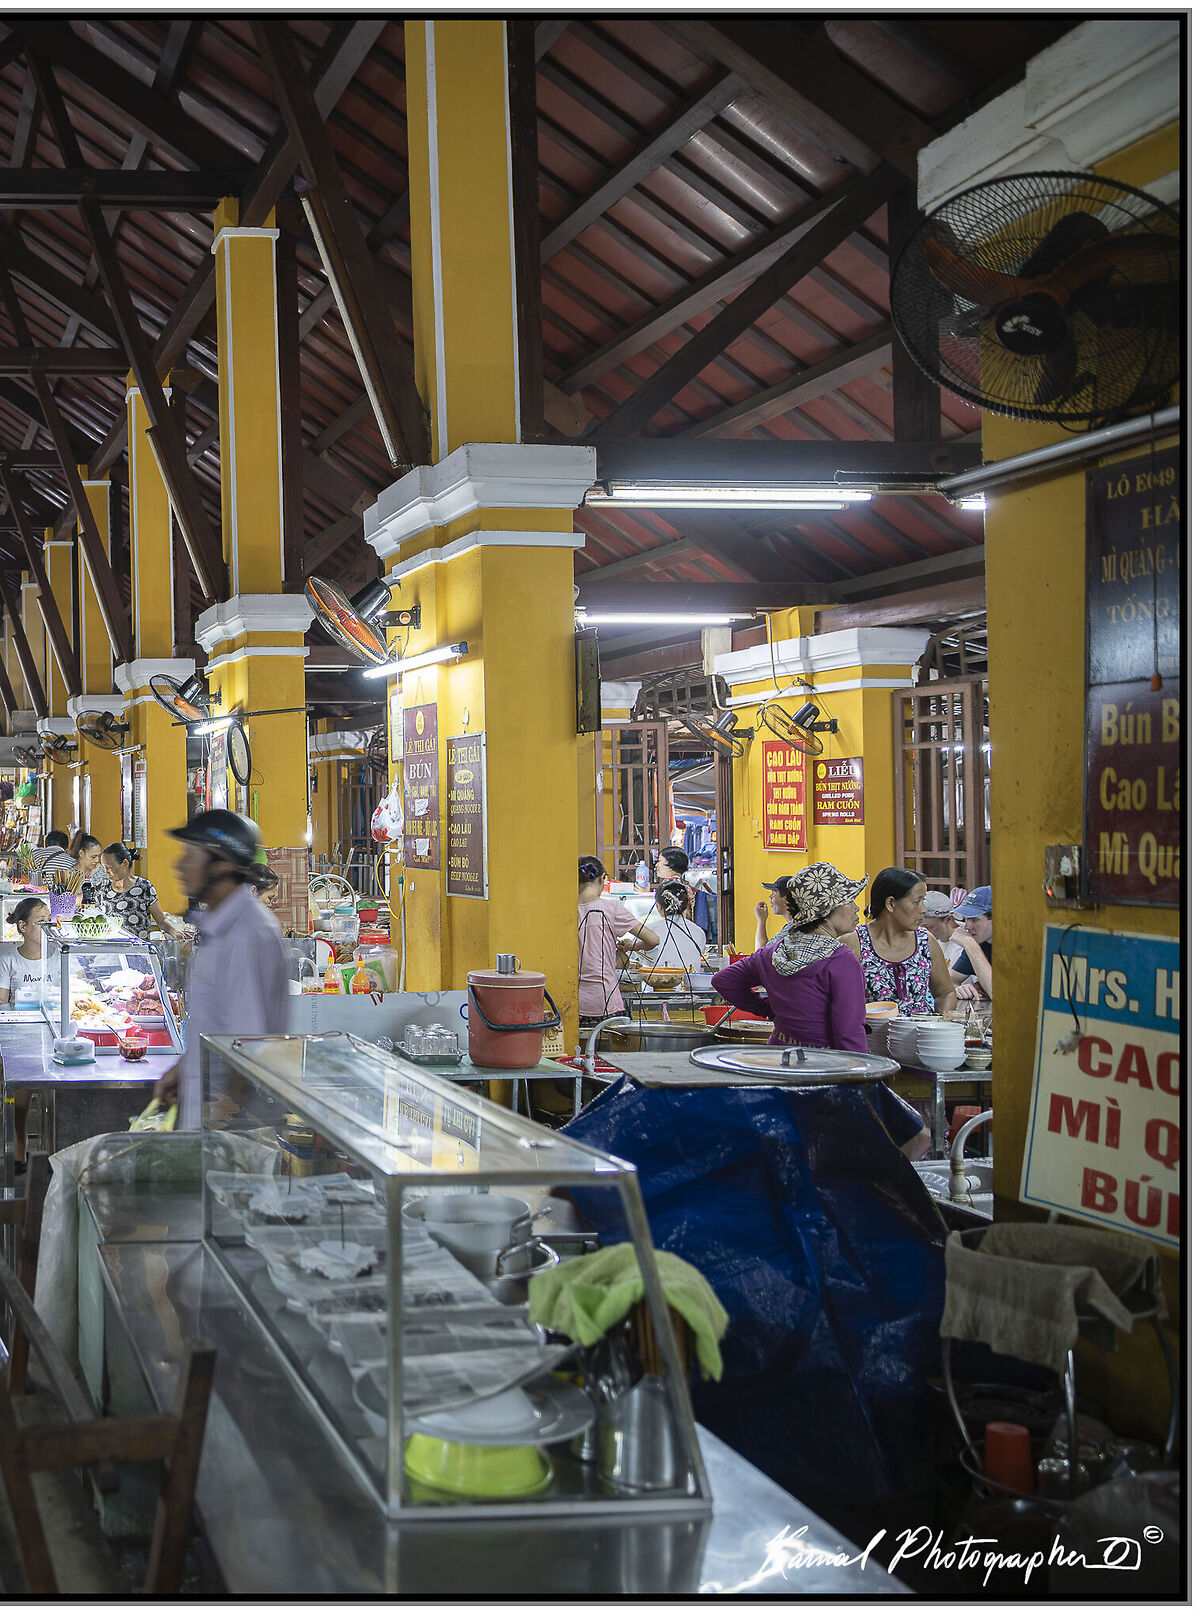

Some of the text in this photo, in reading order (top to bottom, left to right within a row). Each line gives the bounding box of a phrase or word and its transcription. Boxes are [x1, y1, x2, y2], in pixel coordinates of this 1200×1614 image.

[1106, 474, 1130, 499] LÔ
[1101, 545, 1117, 583] MÌ
[1101, 703, 1152, 746] Bún
[448, 744, 456, 765] LÊ
[468, 741, 480, 763] GÁI
[767, 750, 784, 767] CAO
[409, 758, 432, 779] BÚN
[1100, 767, 1147, 811] Cao
[817, 797, 860, 810] RAM CUỐN
[451, 823, 461, 835] CAO
[770, 816, 801, 831] RAM CUỐN
[451, 838, 459, 847] CAO
[770, 831, 786, 844] BÁNH
[1099, 832, 1129, 875] Mì
[1050, 953, 1140, 1013] Mrs.
[1047, 1093, 1122, 1151] MÌ
